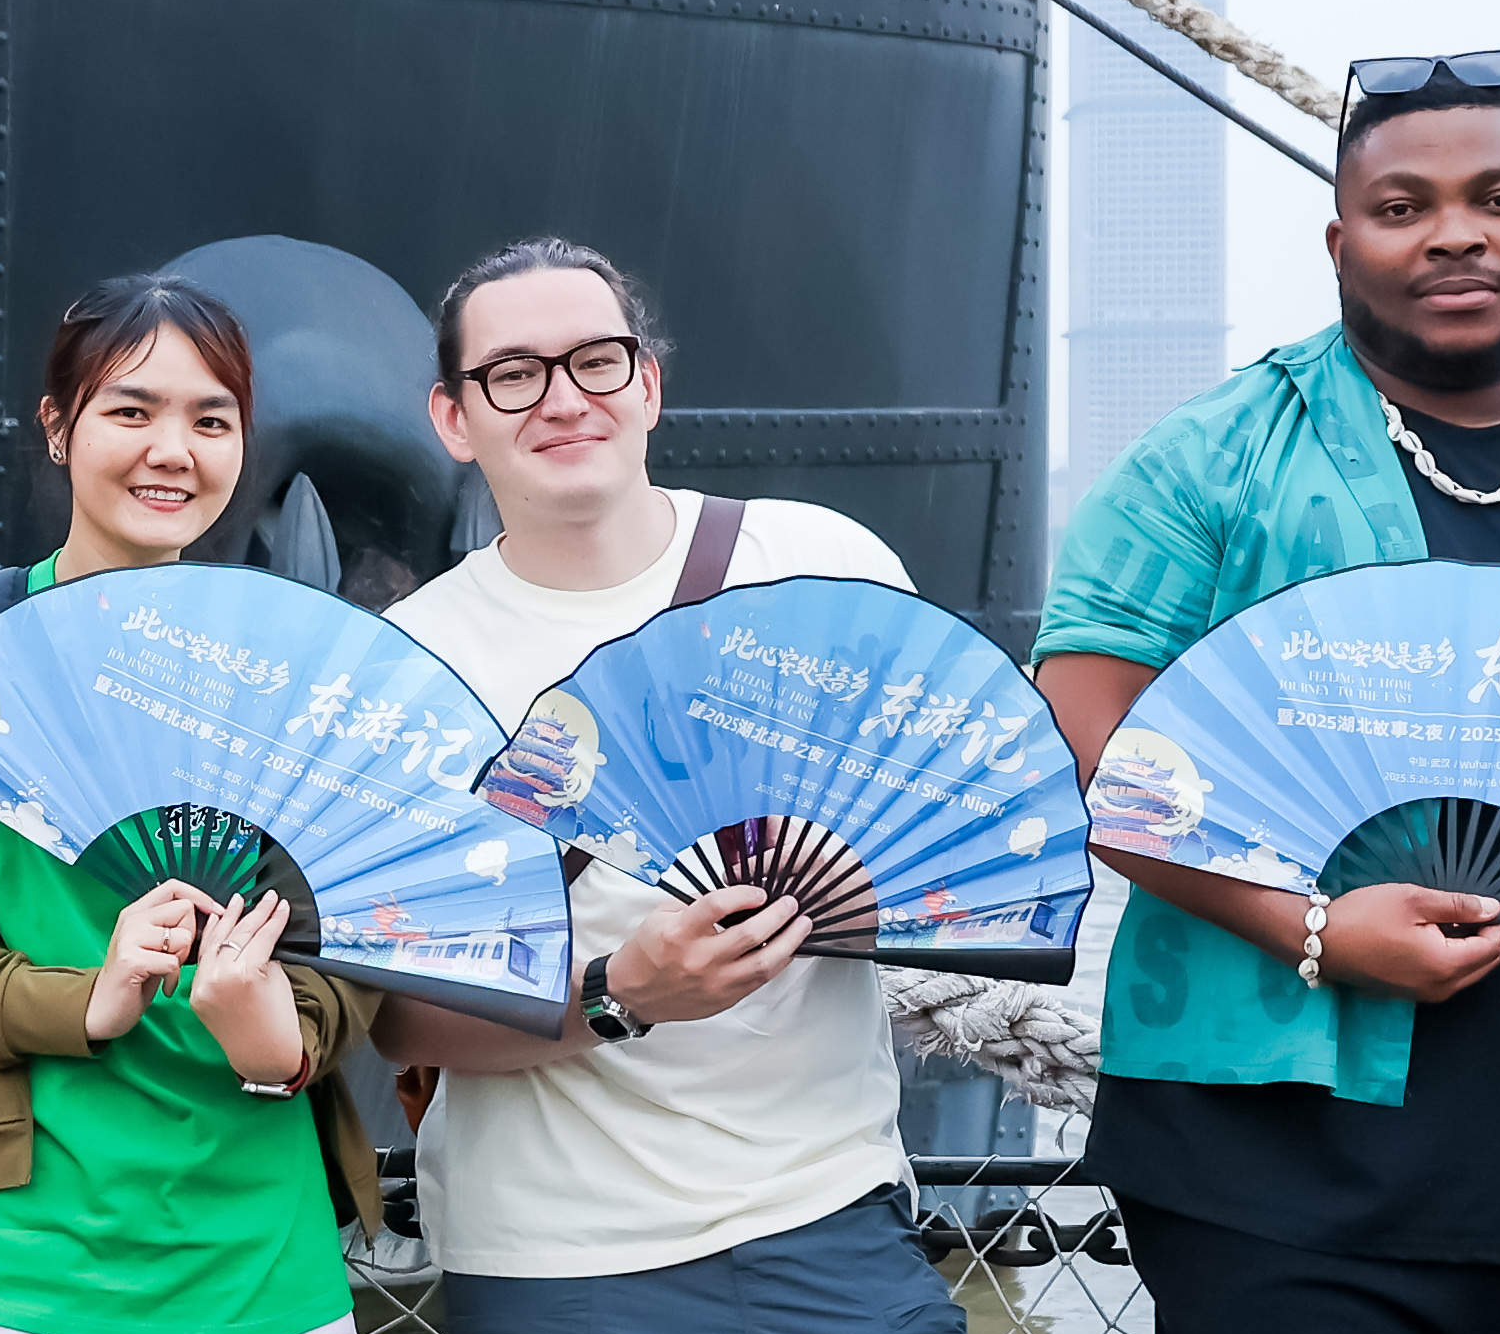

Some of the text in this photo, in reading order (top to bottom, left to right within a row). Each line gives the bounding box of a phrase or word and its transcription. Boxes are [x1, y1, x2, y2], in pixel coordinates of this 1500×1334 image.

[120, 606, 290, 695] 此心安处是吾乡
[1280, 629, 1457, 679] 此心安处是吾乡
[285, 673, 480, 791] 东游记
[858, 673, 1029, 774] 东游记
[262, 751, 305, 778] 2025
[305, 768, 358, 799] Hubei
[358, 788, 407, 820] Story
[407, 807, 458, 835] Night
[836, 755, 874, 780] 2025
[874, 770, 920, 794] Hubei
[921, 783, 959, 808] Story
[961, 793, 1007, 818] Night
